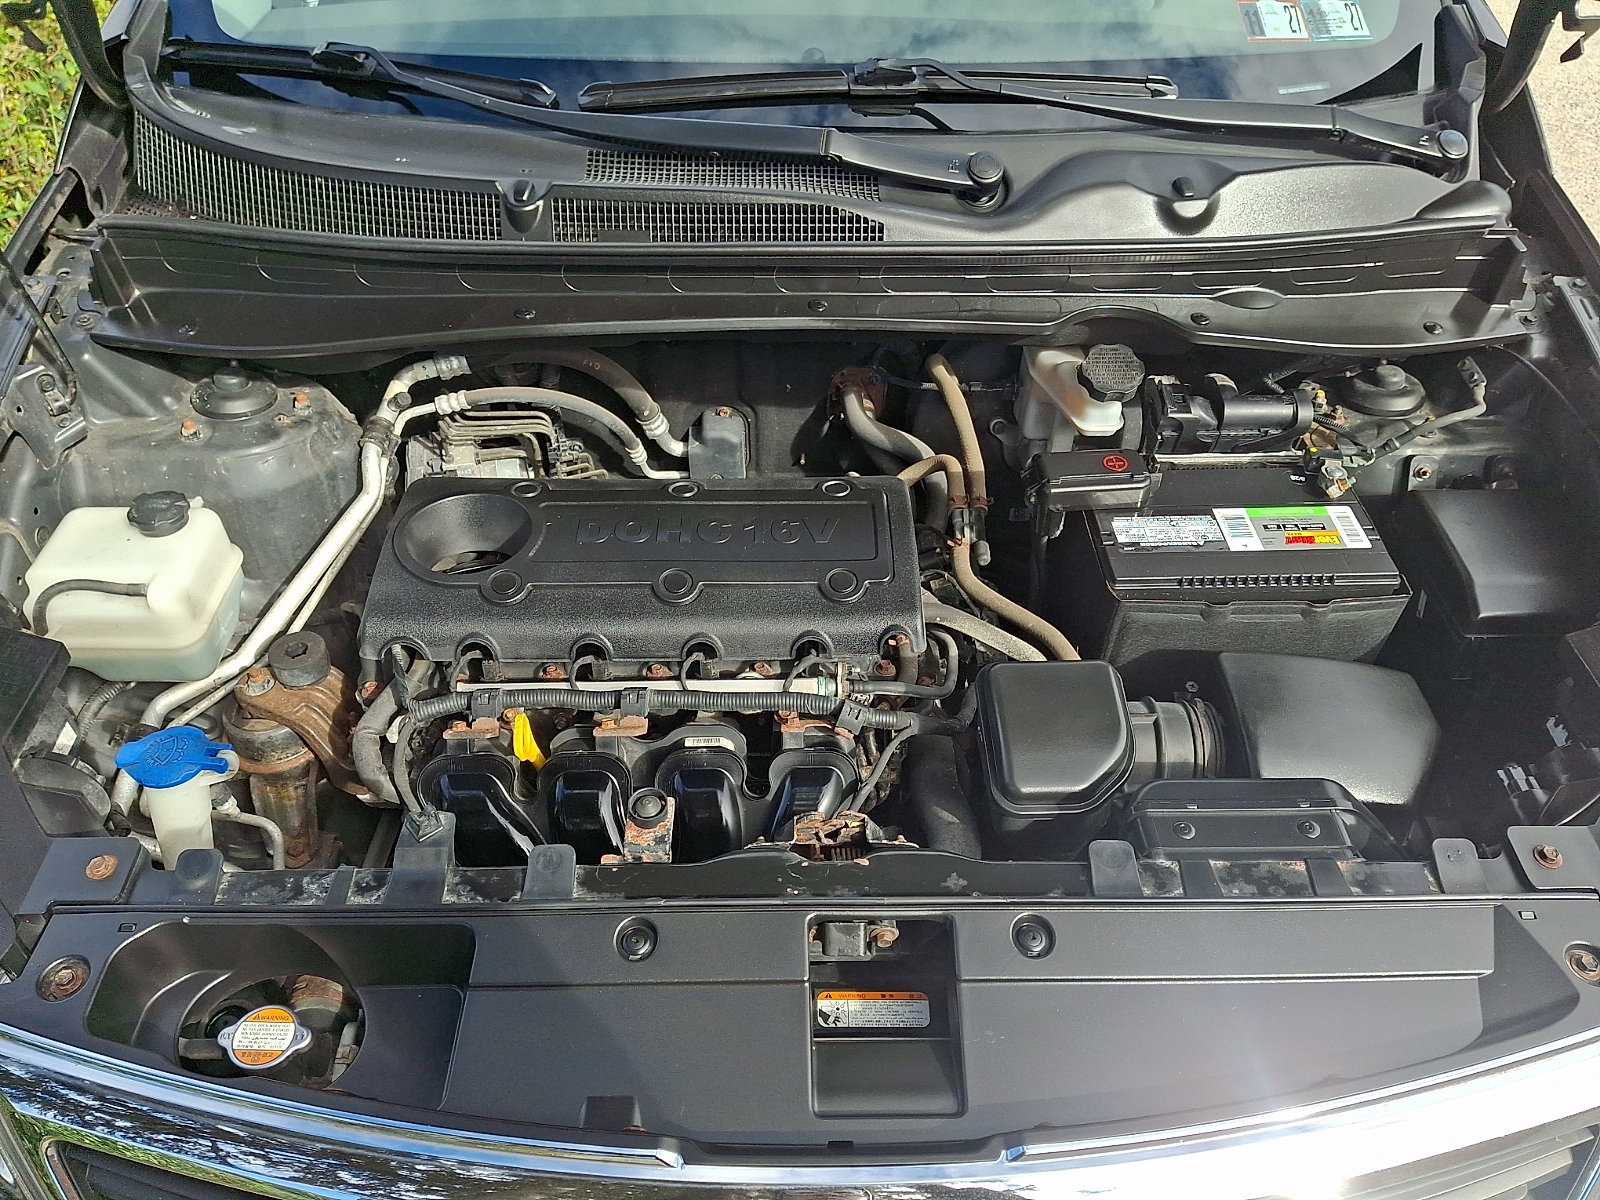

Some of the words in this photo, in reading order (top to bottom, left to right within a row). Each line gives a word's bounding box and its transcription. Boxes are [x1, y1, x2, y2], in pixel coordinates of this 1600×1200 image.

[1283, 5, 1302, 34] 27
[1344, 2, 1364, 31] 27
[575, 517, 733, 545] DOHC
[742, 517, 841, 545] 16V
